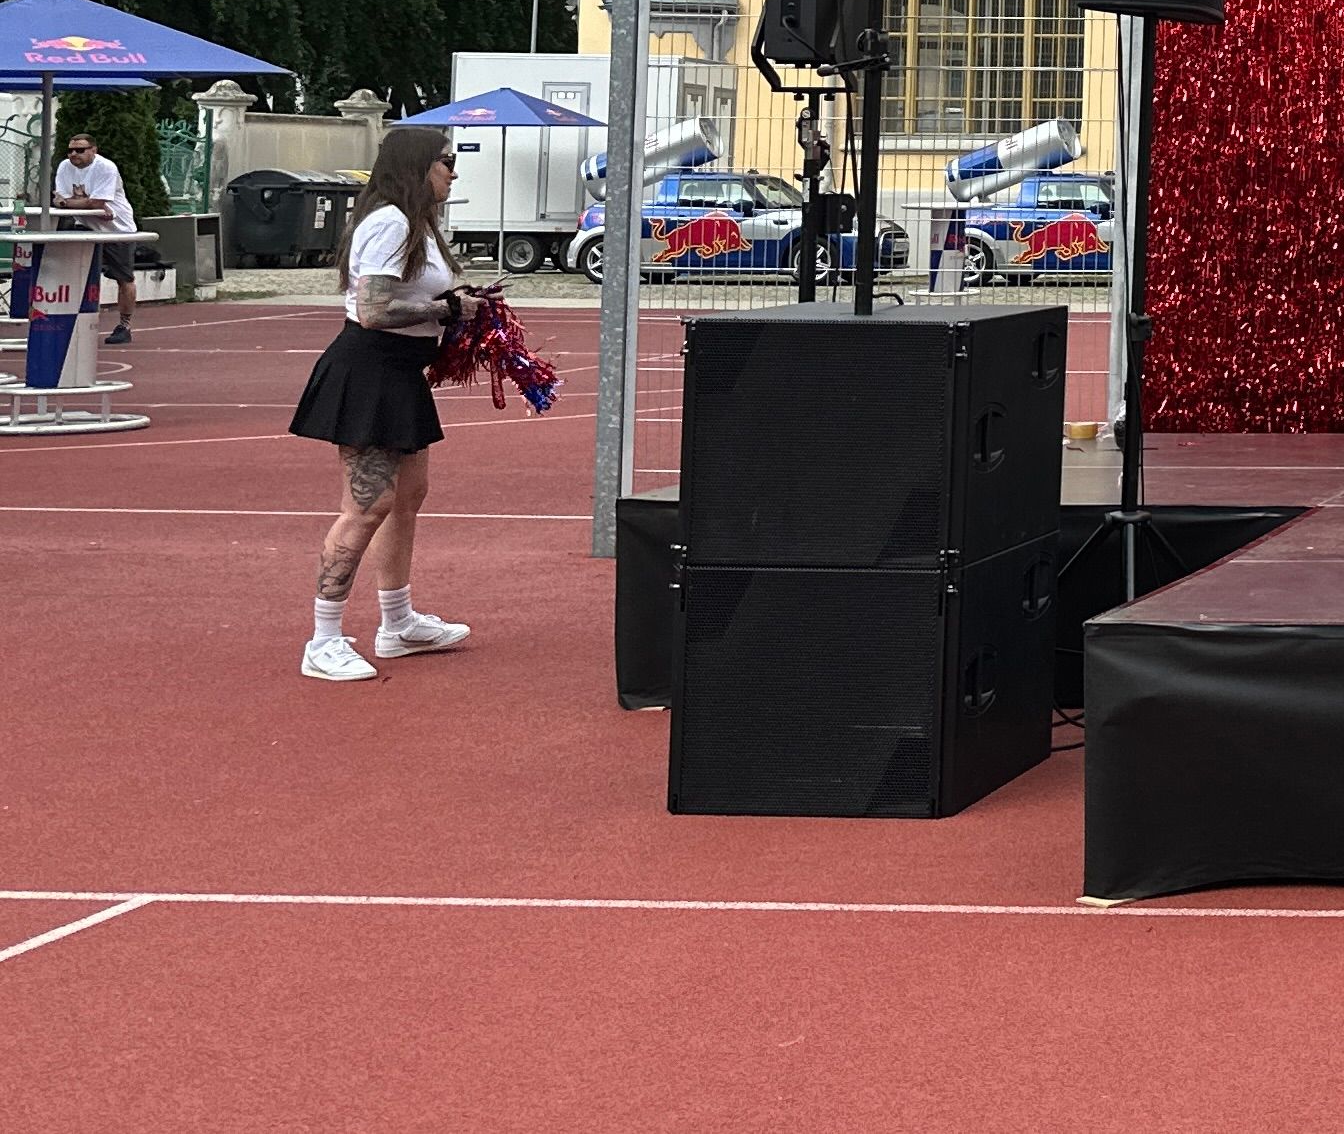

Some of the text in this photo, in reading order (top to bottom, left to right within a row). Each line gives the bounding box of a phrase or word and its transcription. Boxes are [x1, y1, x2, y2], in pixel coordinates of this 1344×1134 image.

[24, 52, 147, 64] Red Bull
[32, 285, 70, 303] Bull
